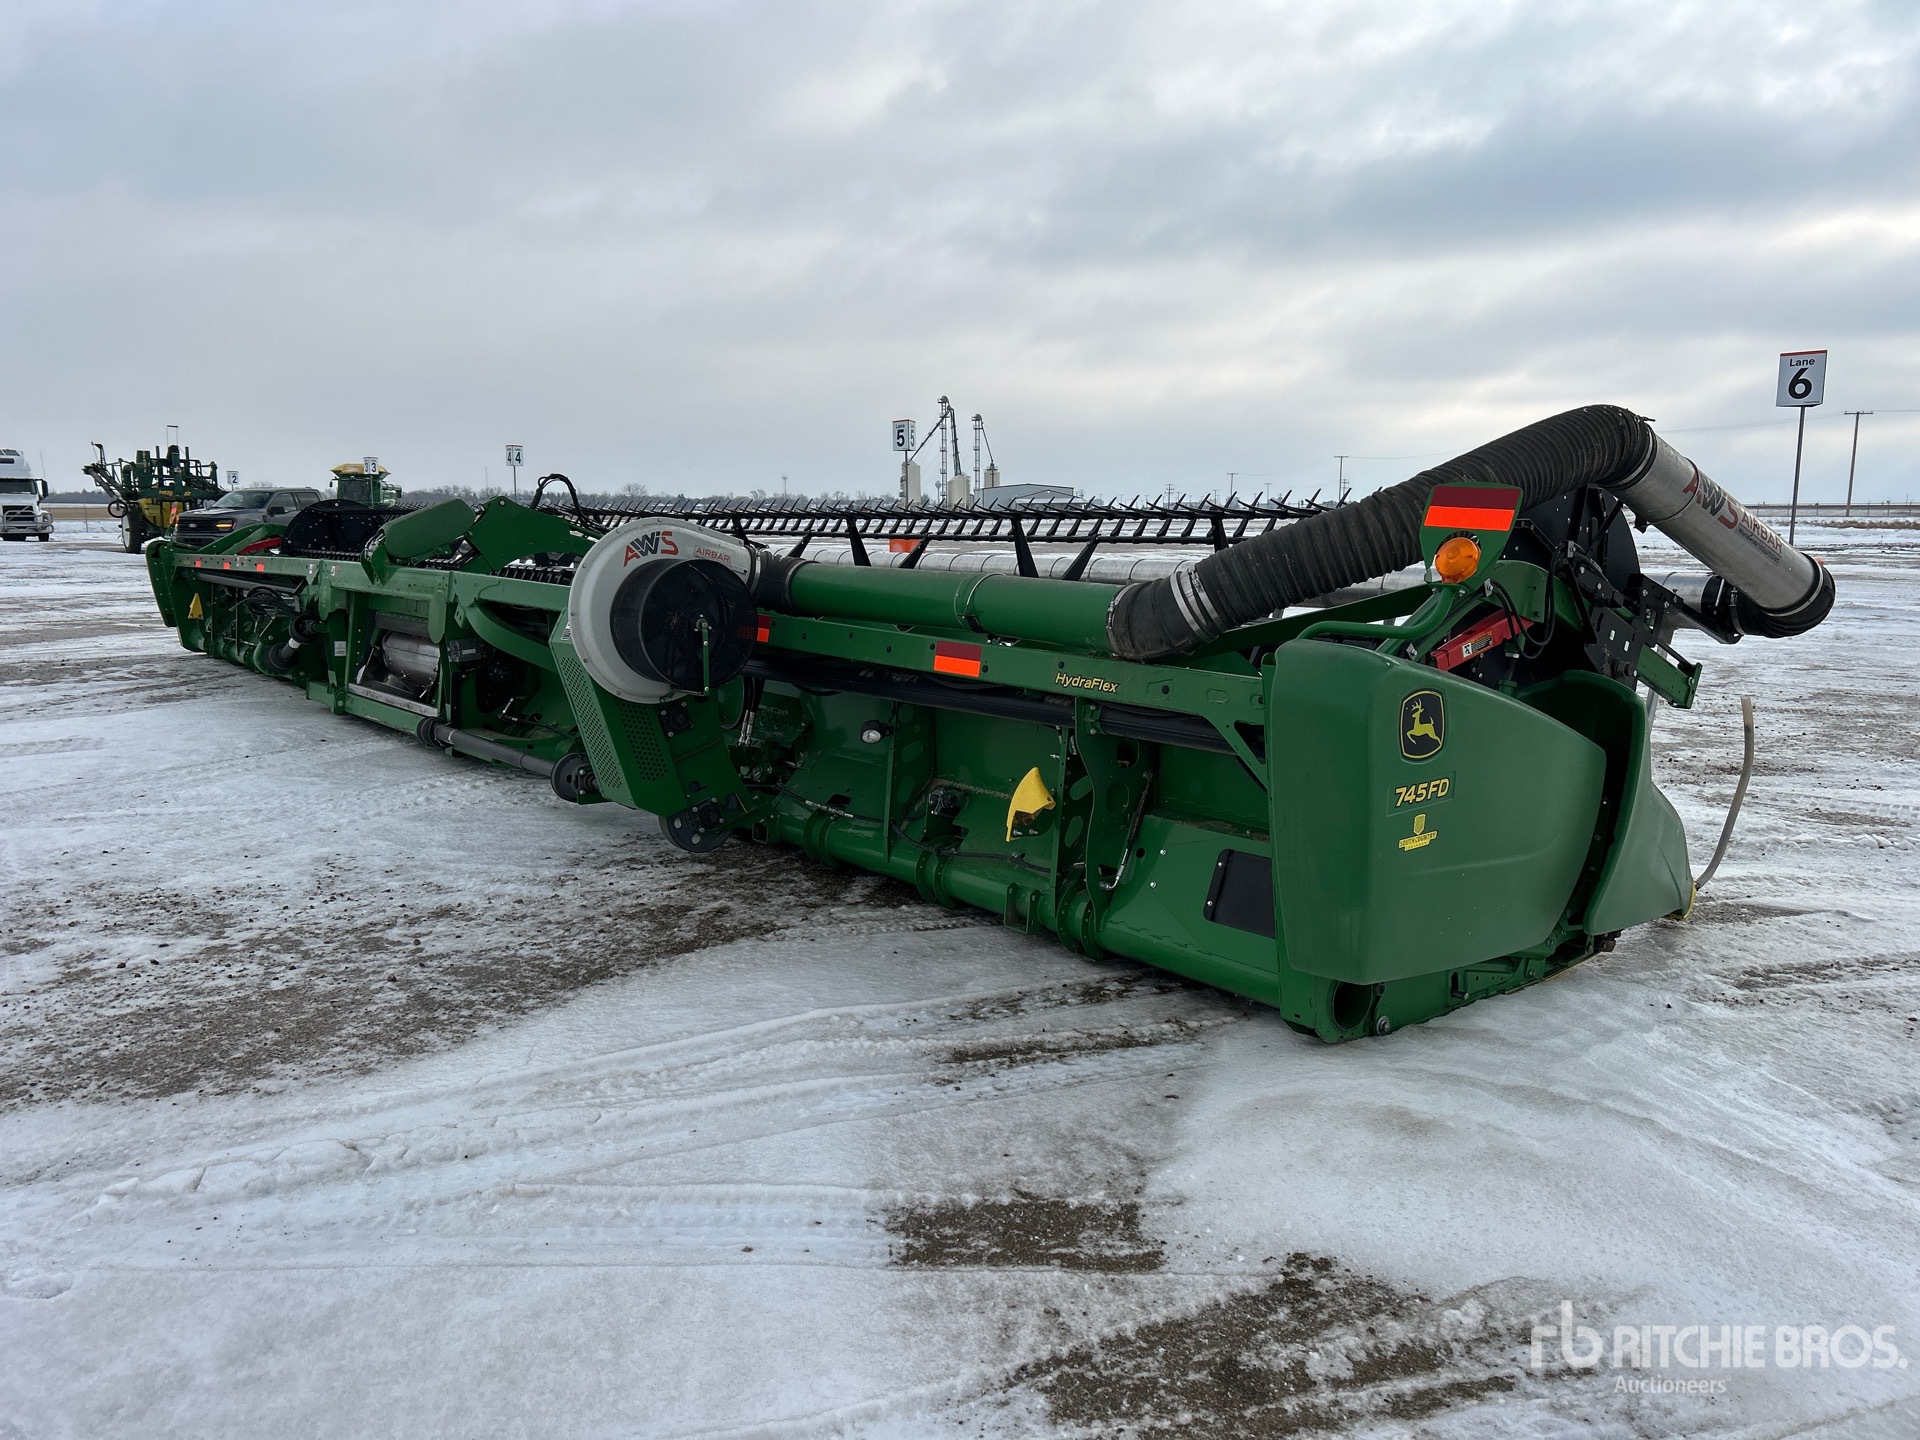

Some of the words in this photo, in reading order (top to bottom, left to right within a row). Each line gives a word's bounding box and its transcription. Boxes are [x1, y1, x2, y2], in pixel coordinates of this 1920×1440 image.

[1789, 358, 1816, 367] Lane
[1788, 367, 1813, 400] 6
[896, 429, 905, 447] 5
[507, 451, 512, 464] 4
[515, 451, 522, 464] 4
[371, 462, 377, 473] 3
[231, 475, 238, 484] 2
[1741, 510, 1783, 554] AIRBAR
[695, 545, 730, 562] AIRBAR
[1055, 672, 1118, 692] HydraFlex
[1395, 778, 1450, 807] 745FD
